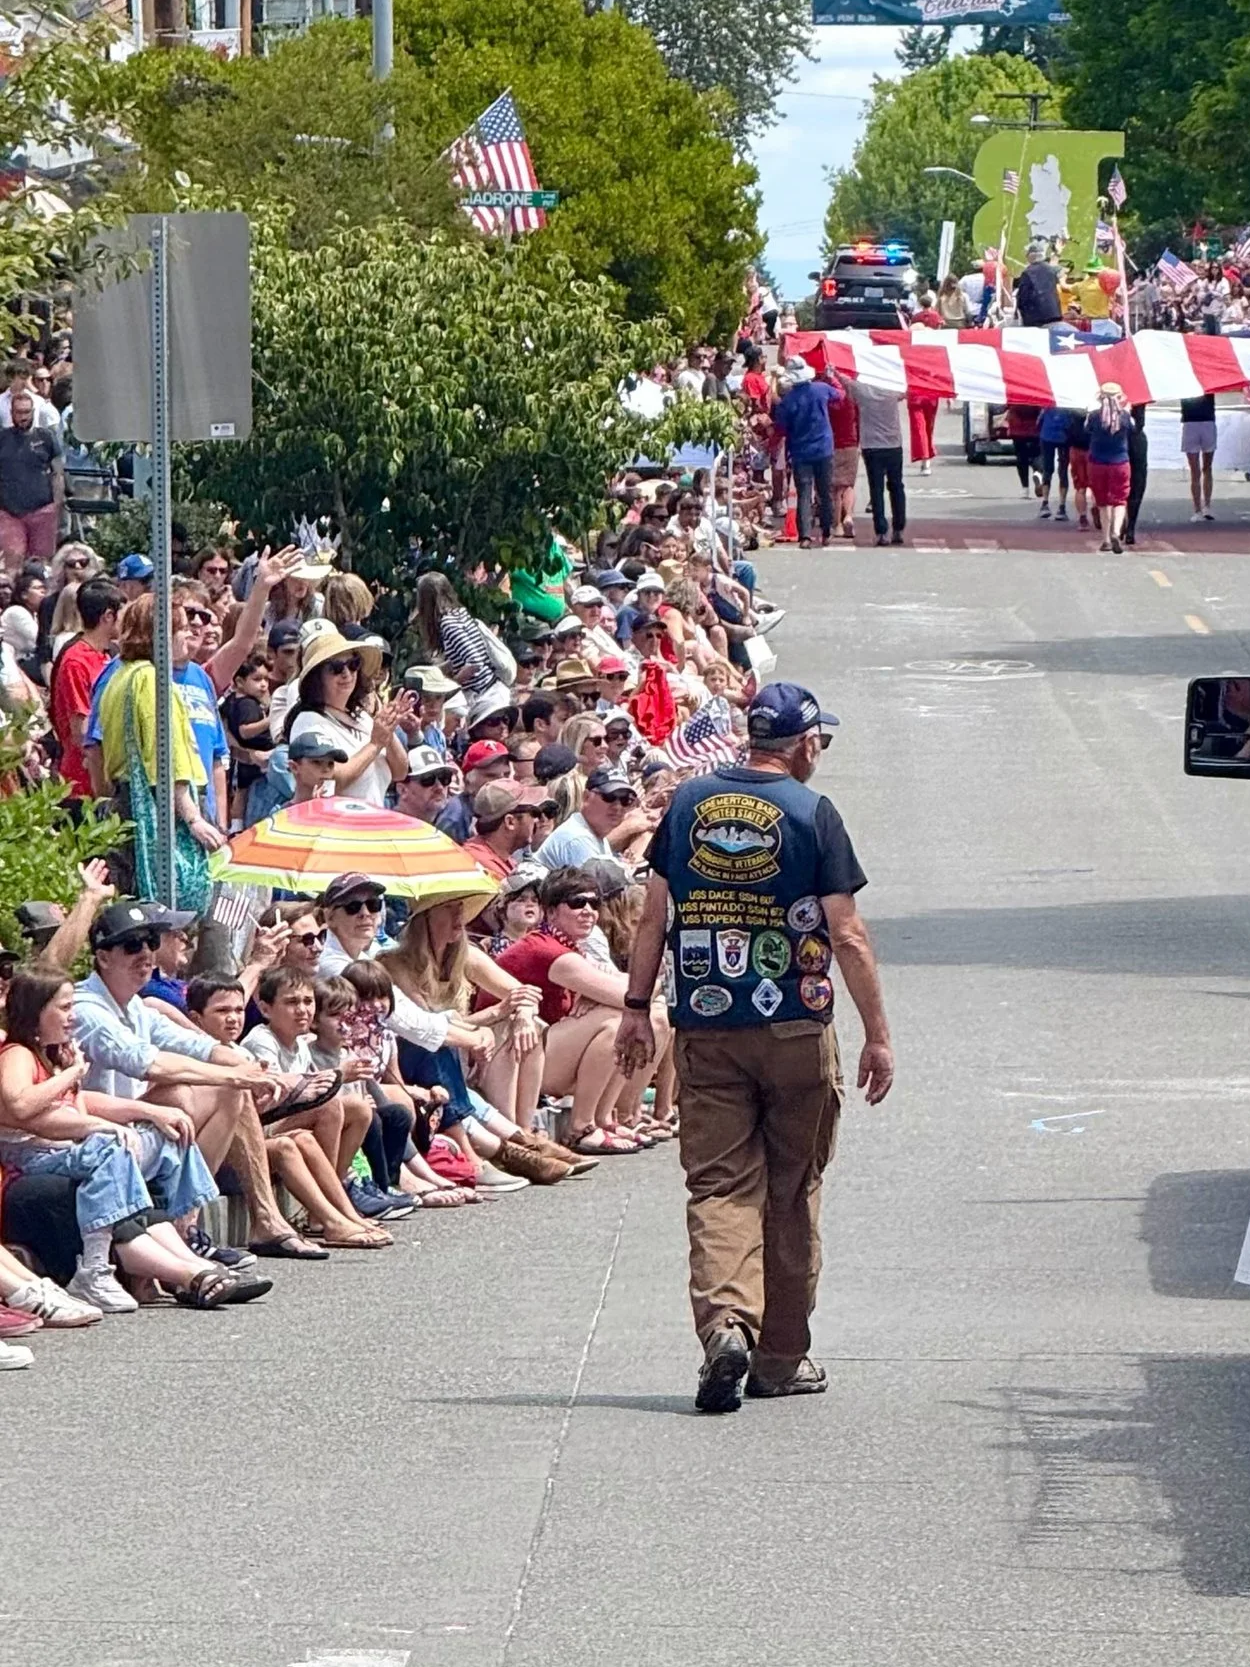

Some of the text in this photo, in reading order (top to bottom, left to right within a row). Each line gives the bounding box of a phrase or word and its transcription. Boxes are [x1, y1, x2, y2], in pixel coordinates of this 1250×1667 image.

[700, 796, 779, 819] BREMERTON BASE
[706, 807, 767, 825] UNITED STATES
[688, 890, 707, 900] USS
[708, 890, 736, 900] DACE
[678, 902, 698, 912] USS
[699, 902, 746, 913] PINTADO
[682, 914, 701, 924] USS
[702, 914, 744, 925] TOPEKA
